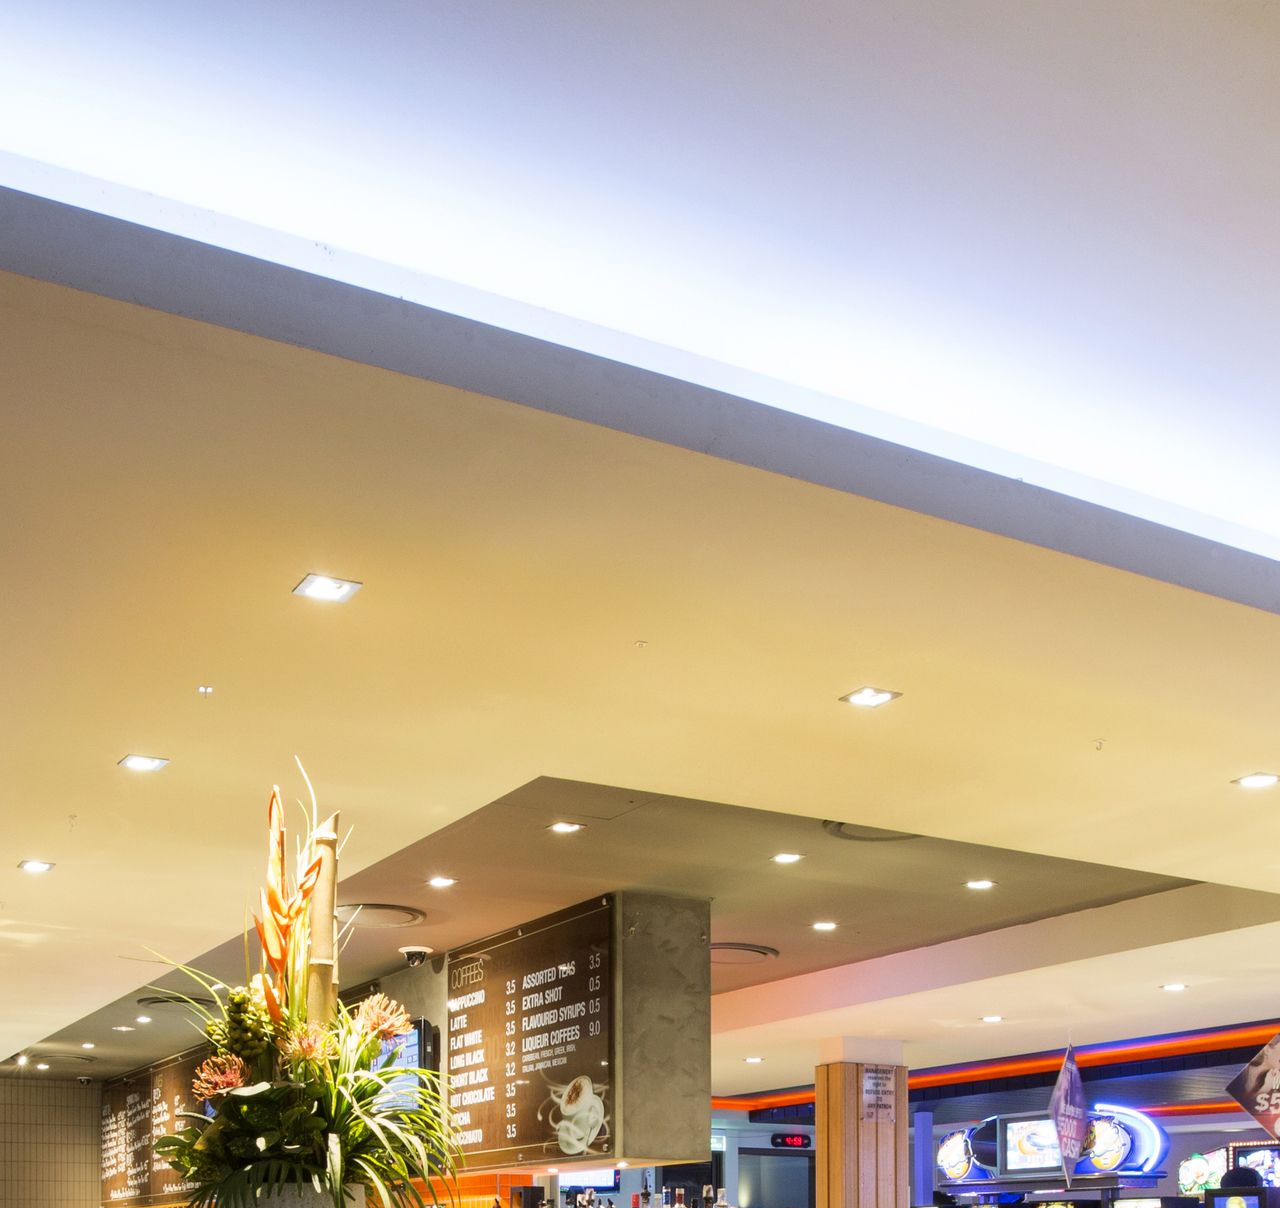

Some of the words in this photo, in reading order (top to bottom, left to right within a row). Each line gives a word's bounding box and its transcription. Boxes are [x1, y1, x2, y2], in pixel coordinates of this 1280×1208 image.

[451, 959, 484, 989] COFFEES
[522, 967, 556, 990] ASSORTED
[558, 960, 576, 979] TEAS
[589, 953, 601, 970] 3.5
[505, 980, 516, 995] 3.5
[522, 994, 545, 1011] EXTRA
[544, 986, 563, 1005] SHOT
[589, 976, 601, 992] 0.5
[450, 1014, 468, 1032] LATTE
[505, 1000, 516, 1015] 3.5
[522, 1008, 558, 1031] FLAVOURED
[558, 1001, 586, 1022] SYRUPS
[589, 998, 601, 1014] 0.5
[450, 1034, 464, 1050] FLAT
[463, 1029, 483, 1047] WHITE
[505, 1021, 516, 1036] 3.5
[522, 1033, 550, 1053] LIQUEUR
[550, 1025, 581, 1045] COFFEES
[589, 1020, 601, 1036] 9.0
[450, 1053, 465, 1070] LONG
[465, 1048, 485, 1067] BLACK
[505, 1041, 516, 1057] 3.2
[450, 1072, 469, 1089] SHORT
[468, 1067, 489, 1086] BLACK
[505, 1062, 516, 1077] 3.2
[450, 1093, 462, 1108] HOT
[462, 1086, 495, 1106] CHOCOLATE
[505, 1082, 516, 1098] 3.5
[506, 1103, 517, 1118] 3.5
[506, 1124, 517, 1138] 3.5
